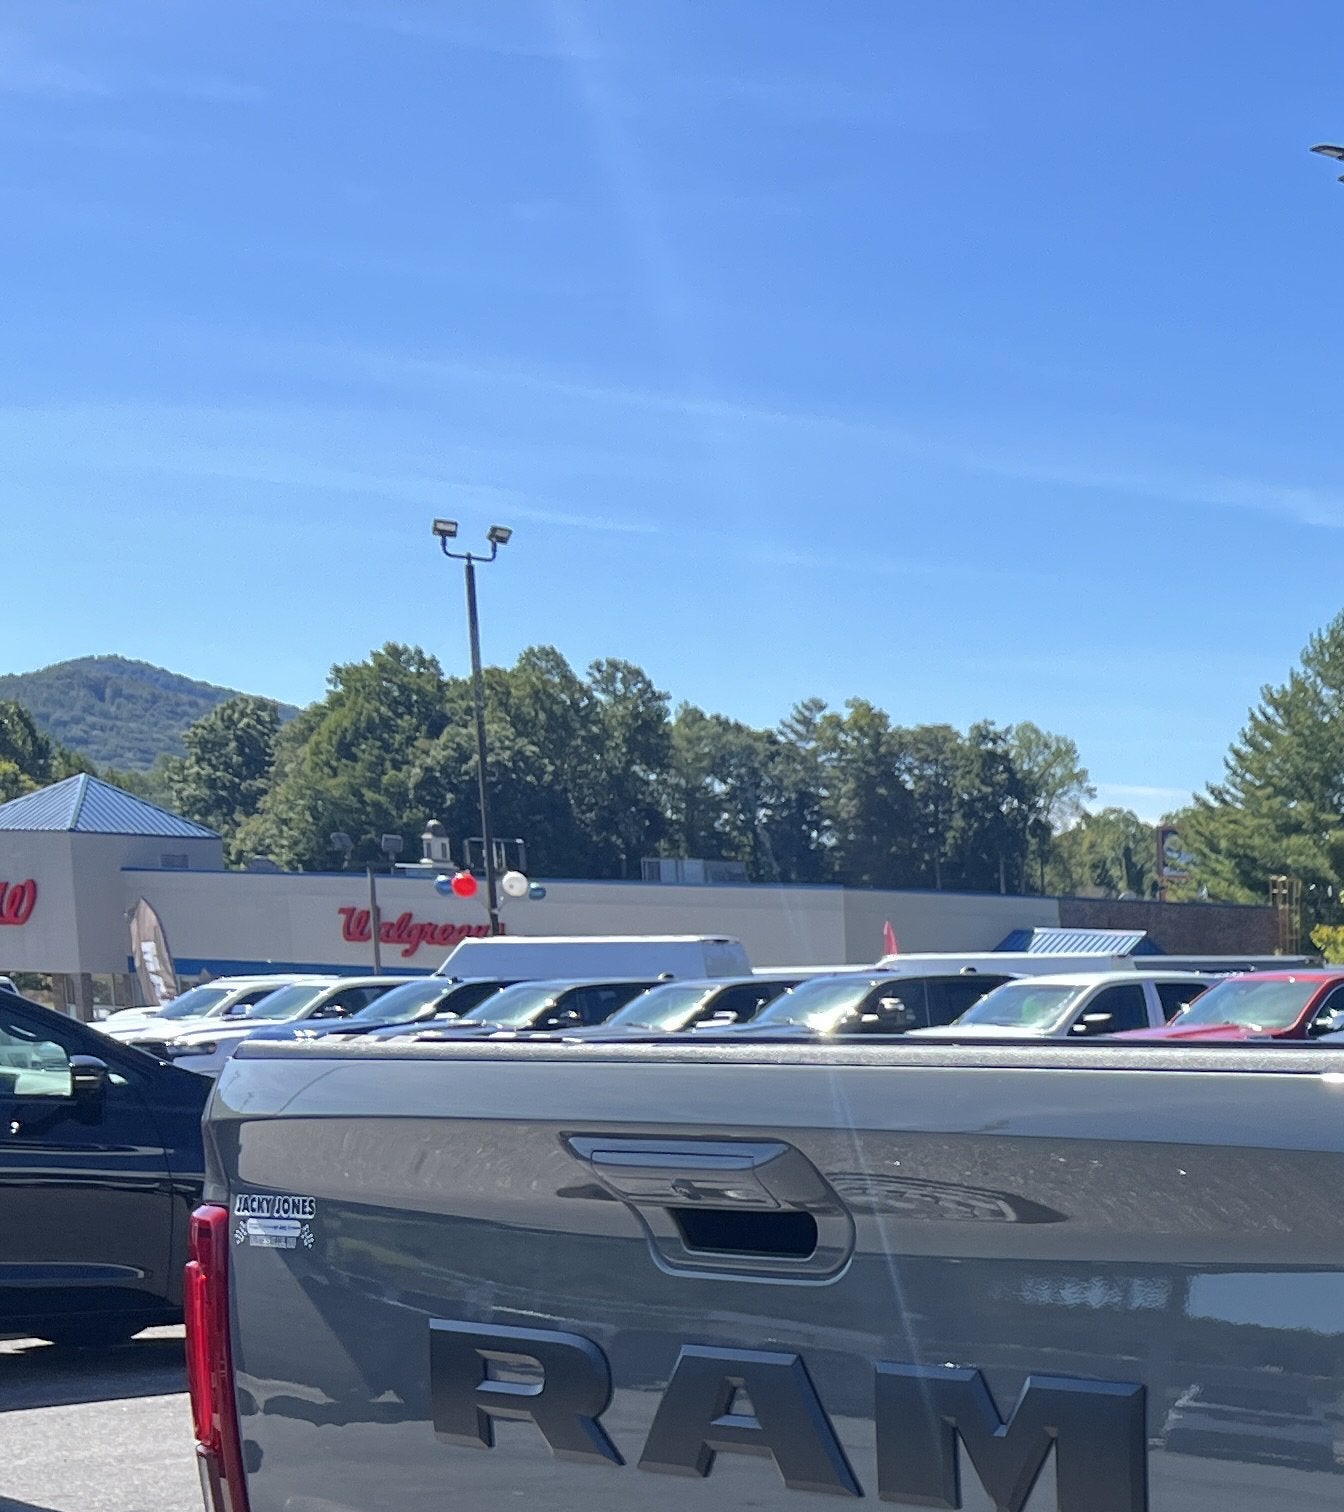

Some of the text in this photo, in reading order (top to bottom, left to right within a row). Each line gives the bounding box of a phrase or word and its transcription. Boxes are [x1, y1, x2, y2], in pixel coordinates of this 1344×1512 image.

[338, 906, 506, 957] Walgreen
[234, 1195, 316, 1219] JACKY JONES
